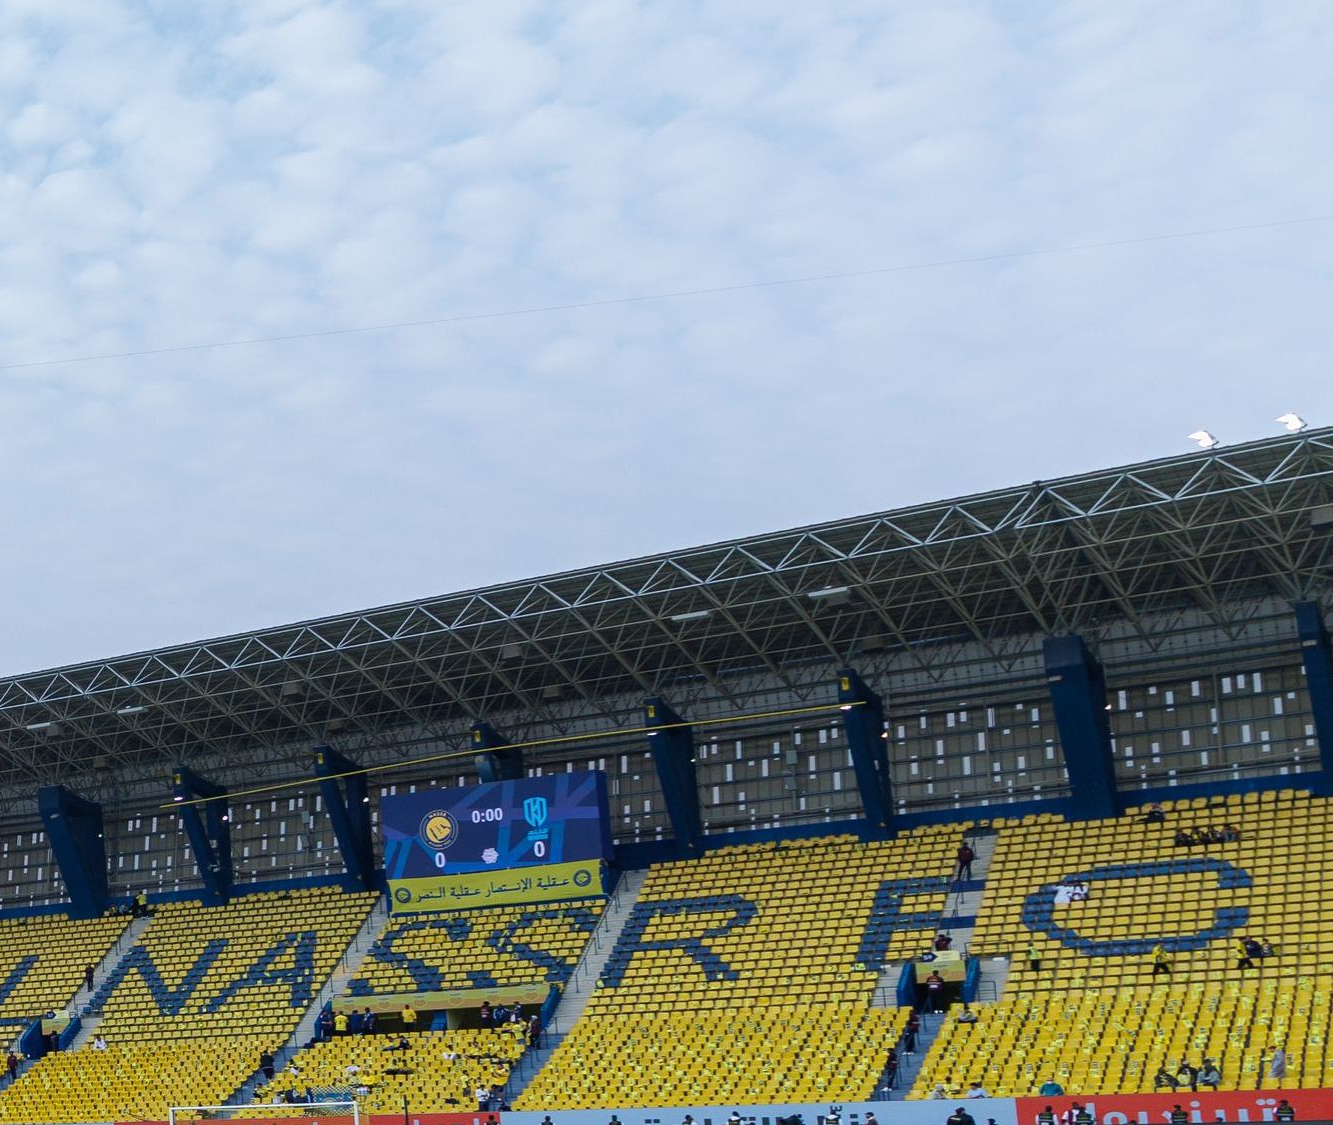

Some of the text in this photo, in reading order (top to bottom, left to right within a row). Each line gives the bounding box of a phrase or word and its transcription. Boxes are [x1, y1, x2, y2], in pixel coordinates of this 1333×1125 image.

[471, 807, 503, 823] 0:00
[534, 841, 545, 857] 0
[435, 852, 445, 868] 0
